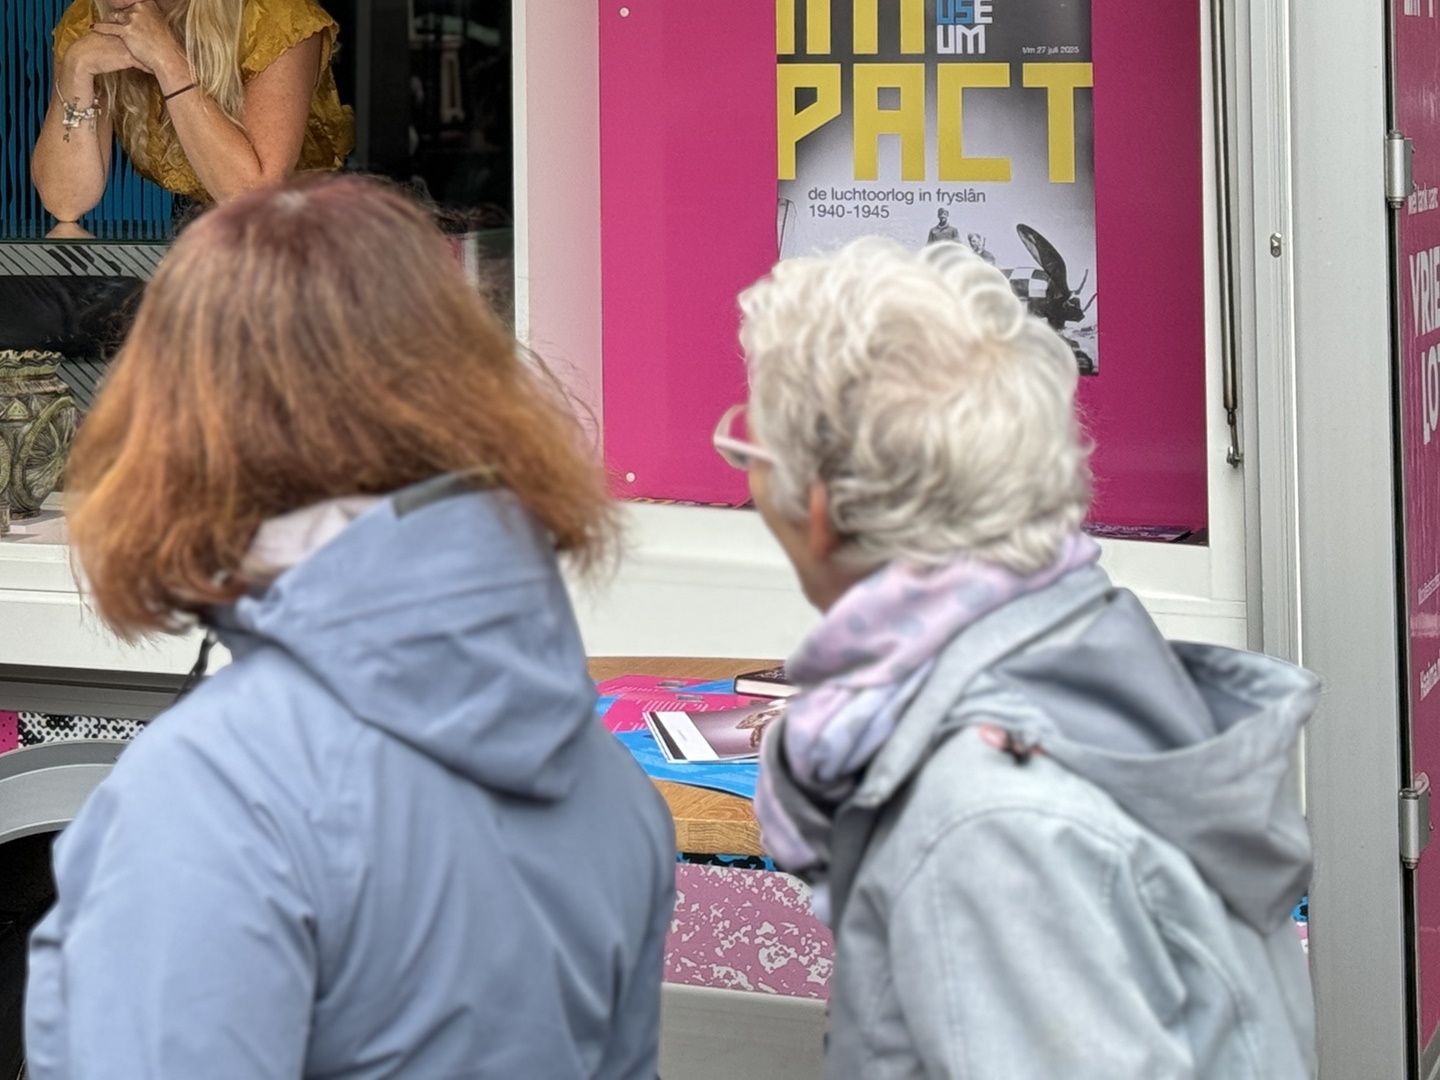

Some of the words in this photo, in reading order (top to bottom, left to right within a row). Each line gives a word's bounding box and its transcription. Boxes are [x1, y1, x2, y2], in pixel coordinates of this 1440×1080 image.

[937, 24, 985, 54] UM
[1037, 46, 1046, 54] 27
[776, 62, 1094, 183] PACT
[808, 187, 827, 201] de
[831, 187, 914, 205] luchtoorlog
[919, 188, 932, 202] in
[936, 188, 987, 206] fryslân
[810, 204, 890, 219] 1940-1945
